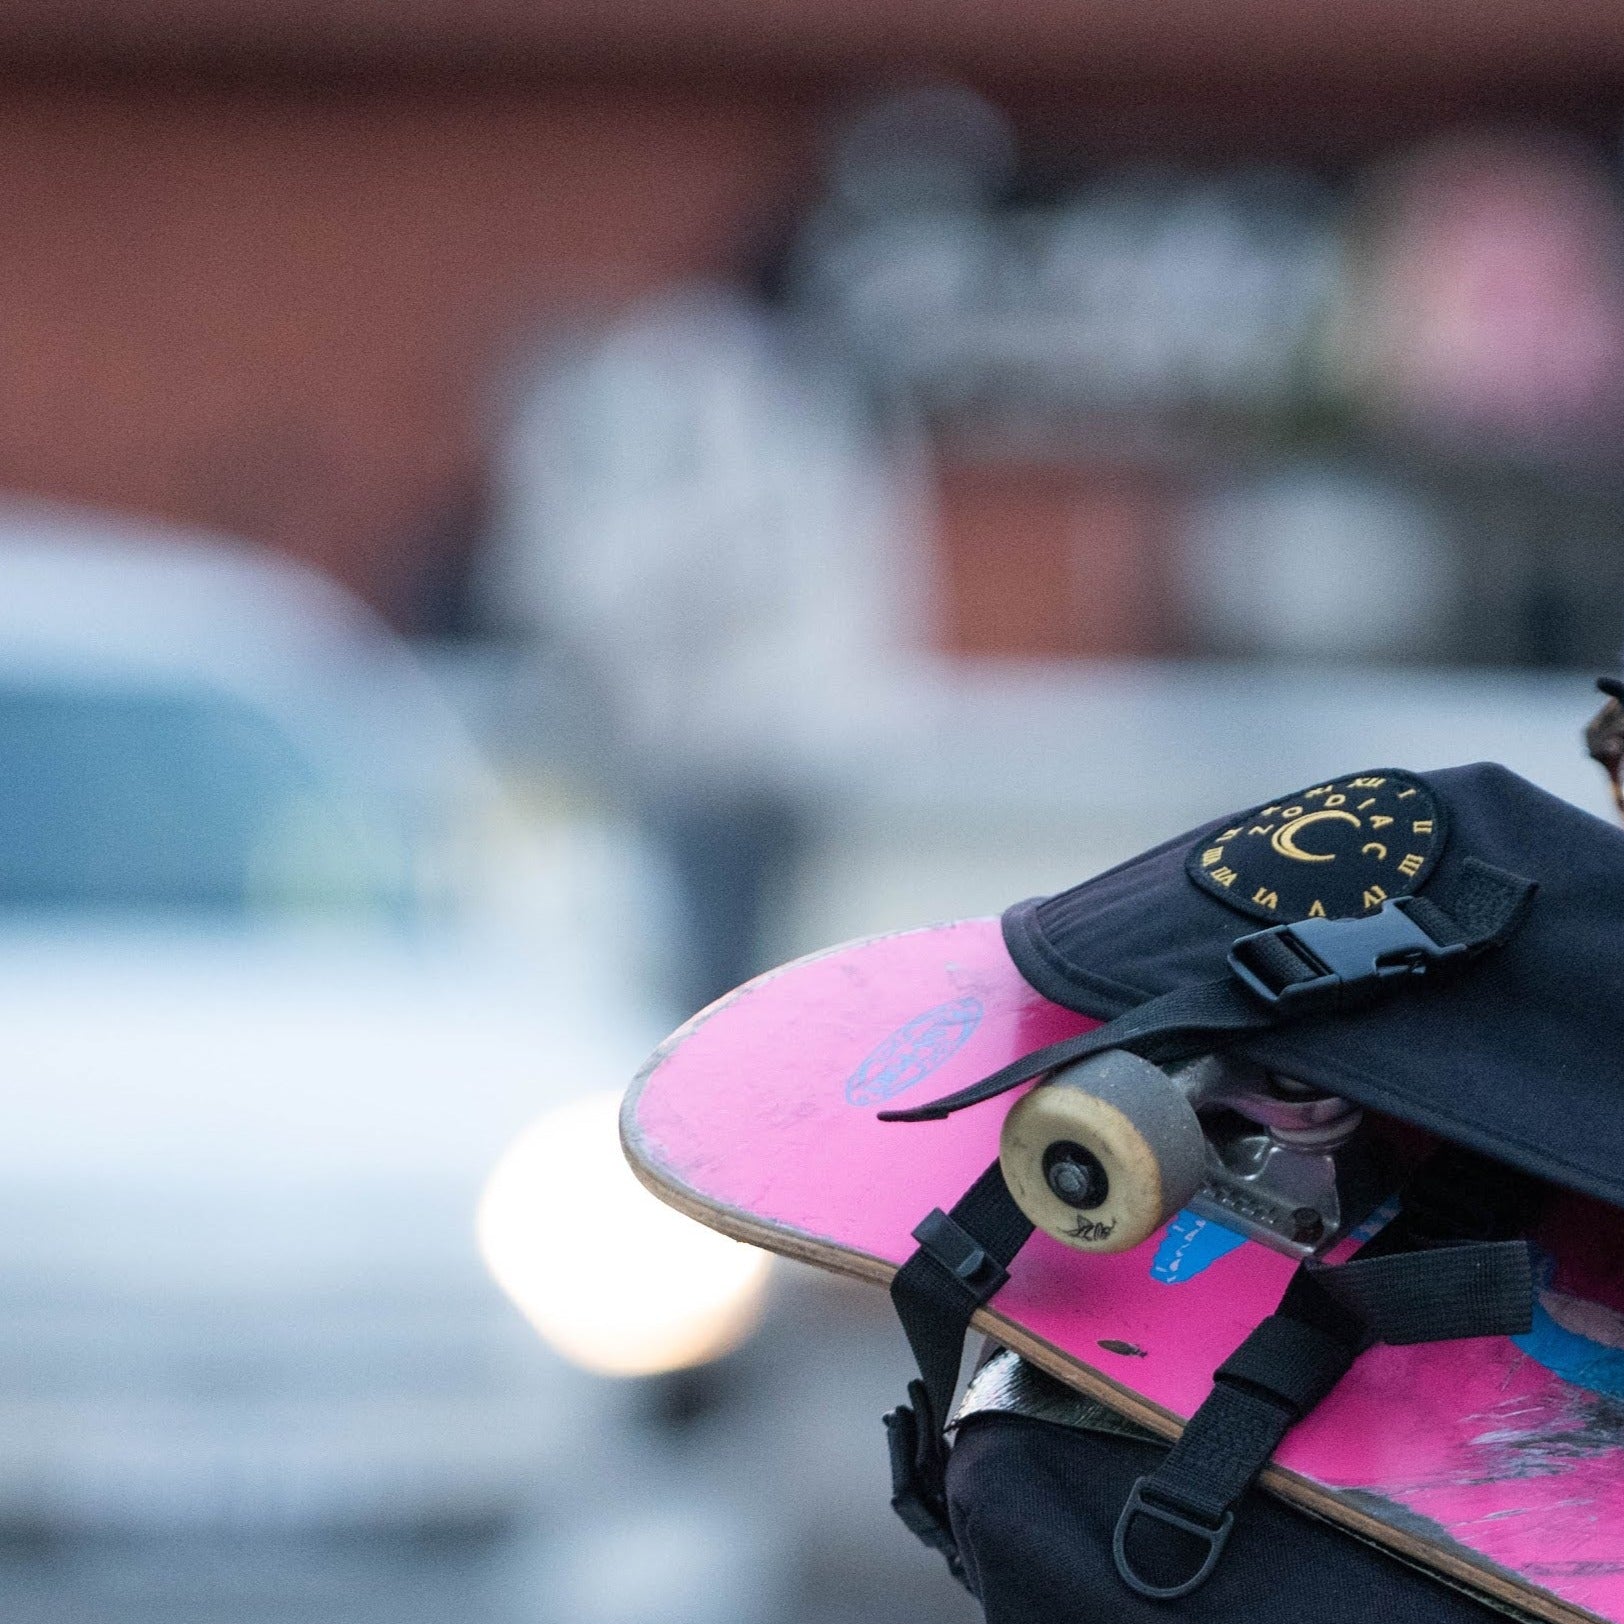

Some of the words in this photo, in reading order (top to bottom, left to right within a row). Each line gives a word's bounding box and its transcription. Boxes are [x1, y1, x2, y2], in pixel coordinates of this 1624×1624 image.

[1248, 793, 1394, 860] ZODIAC
[1413, 820, 1433, 834] II
[1398, 853, 1425, 877] III
[1252, 887, 1278, 909] VI
[1308, 900, 1326, 917] V
[1363, 885, 1387, 909] IV
